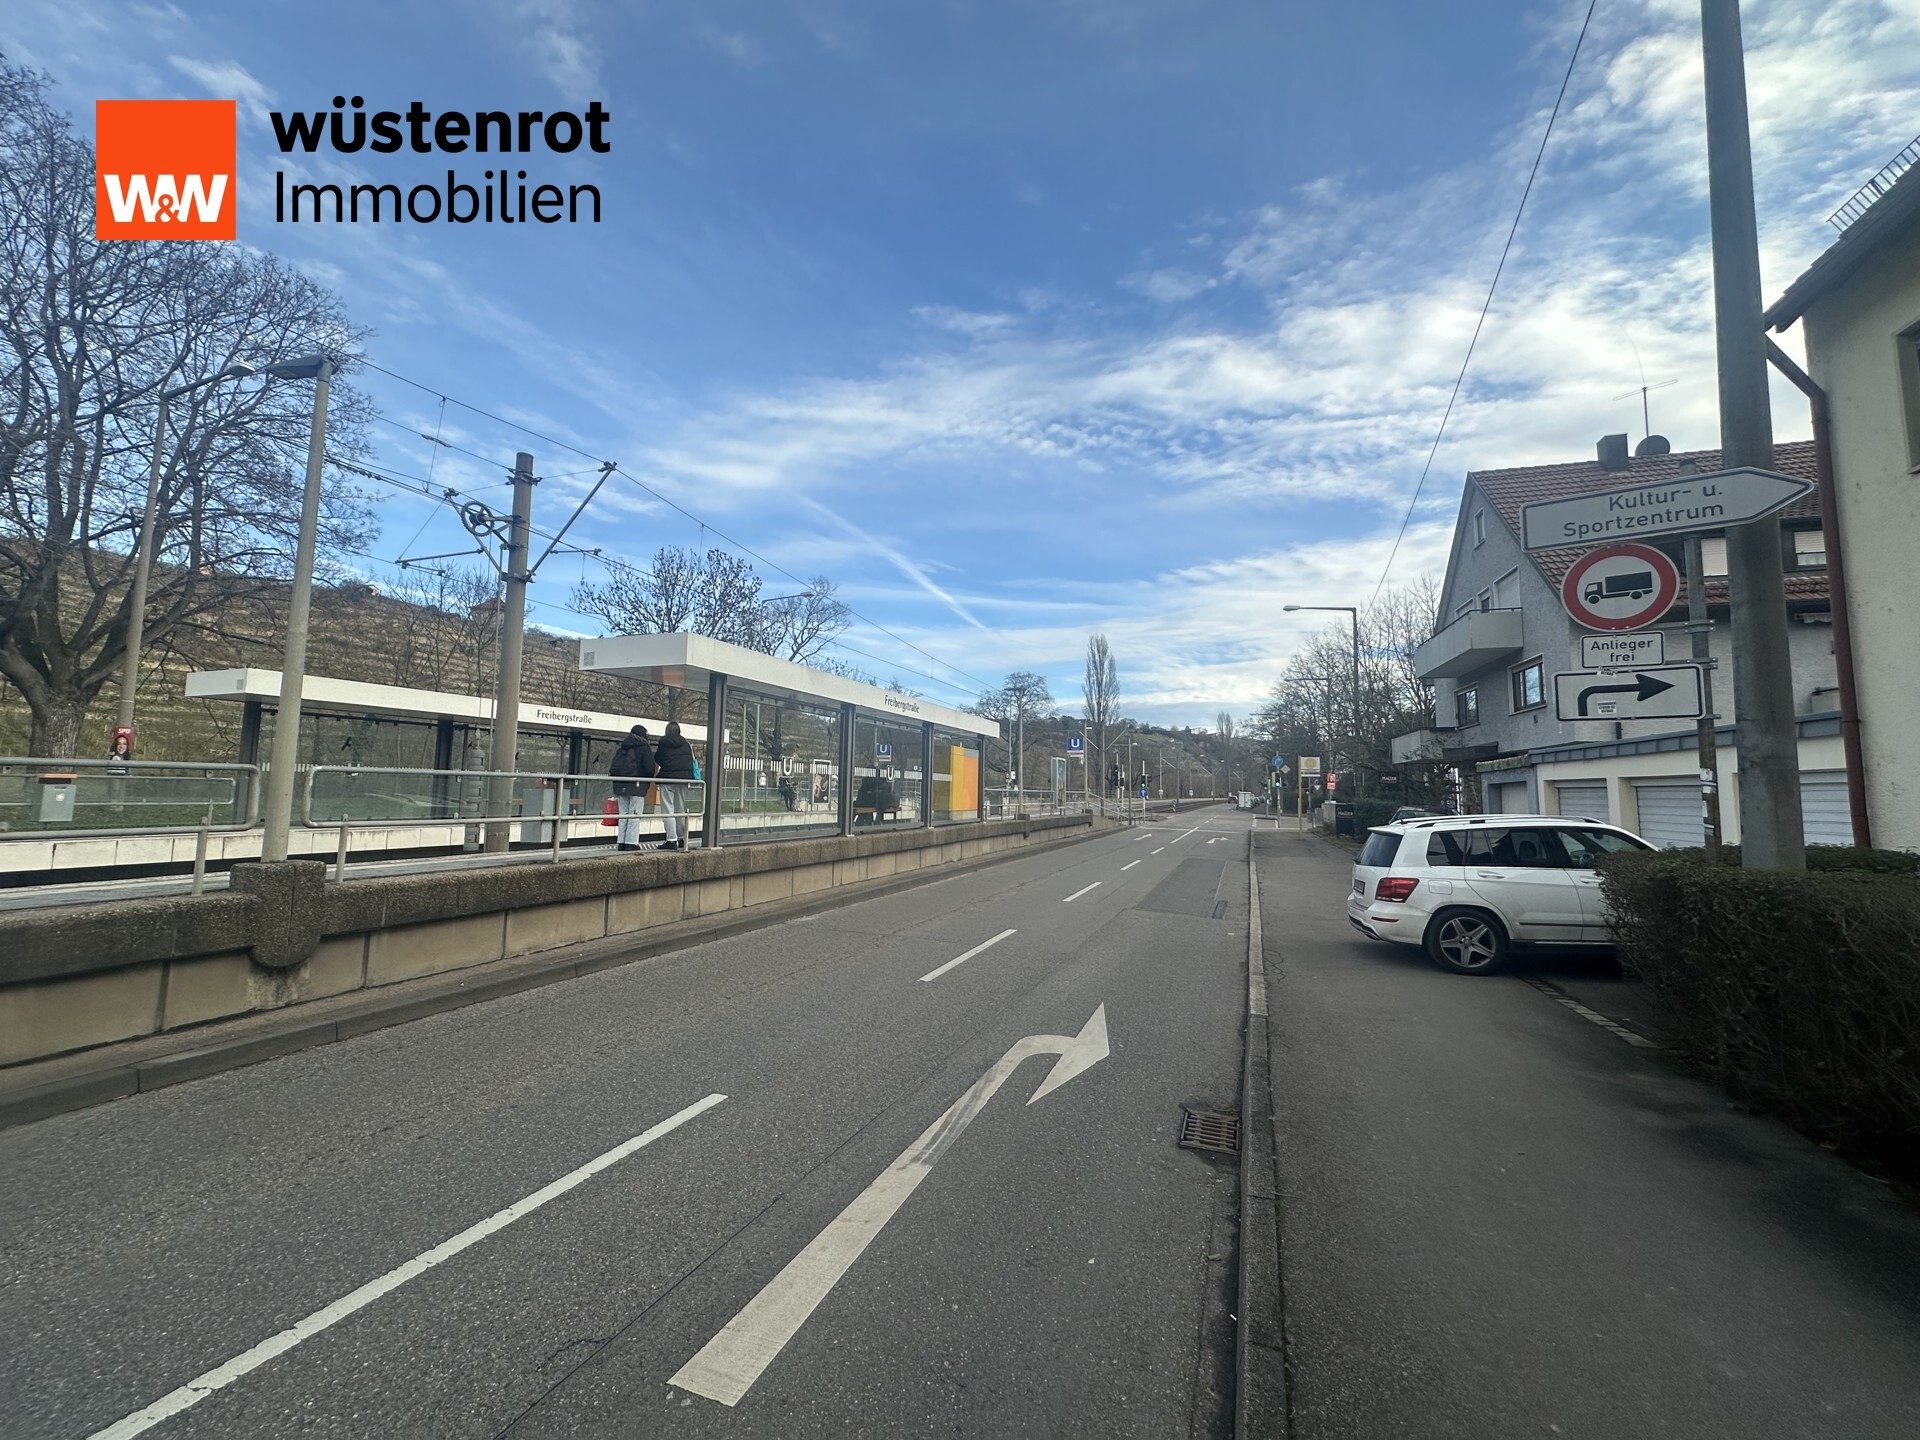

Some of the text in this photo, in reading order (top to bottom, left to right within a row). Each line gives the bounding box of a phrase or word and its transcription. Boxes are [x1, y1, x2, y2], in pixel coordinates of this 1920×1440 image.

[1609, 484, 1723, 511] Kultur- u.
[1563, 503, 1724, 538] Sportzentrum
[1591, 639, 1653, 651] Anlieger
[1610, 651, 1635, 662] frei
[536, 709, 593, 724] Freibergstraße
[879, 744, 888, 753] U
[1070, 738, 1080, 748] U
